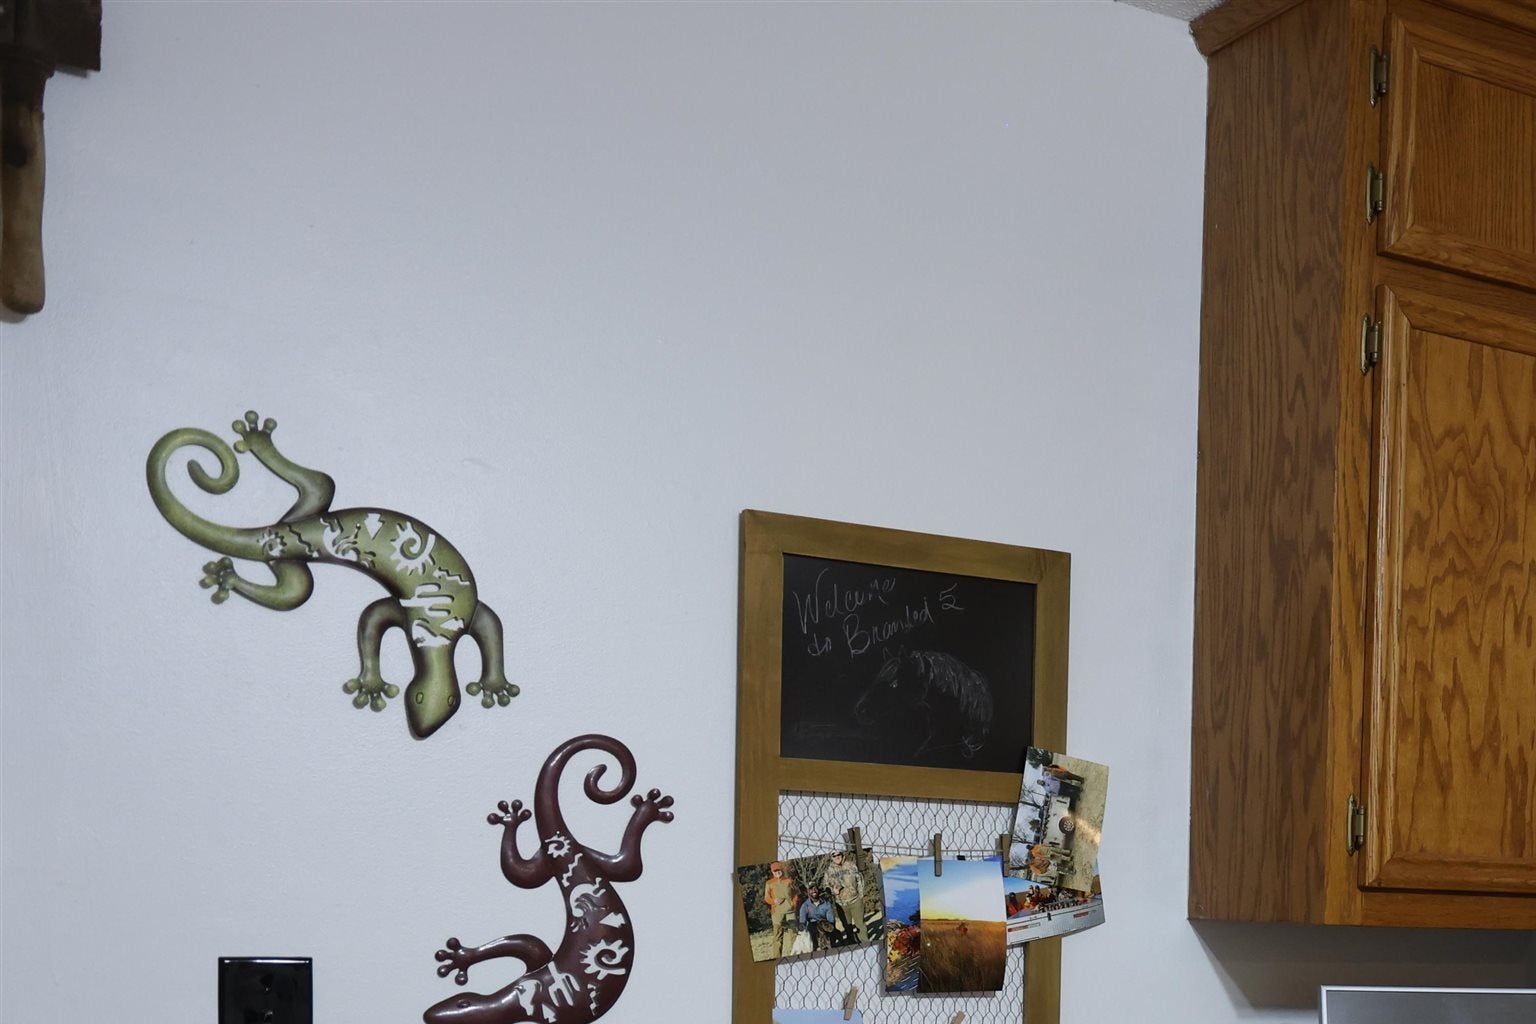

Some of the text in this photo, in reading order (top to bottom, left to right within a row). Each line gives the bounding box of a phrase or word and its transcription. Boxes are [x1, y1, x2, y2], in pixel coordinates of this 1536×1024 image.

[793, 568, 896, 634] Welcome
[843, 597, 934, 658] Branded
[940, 583, 965, 610] 5
